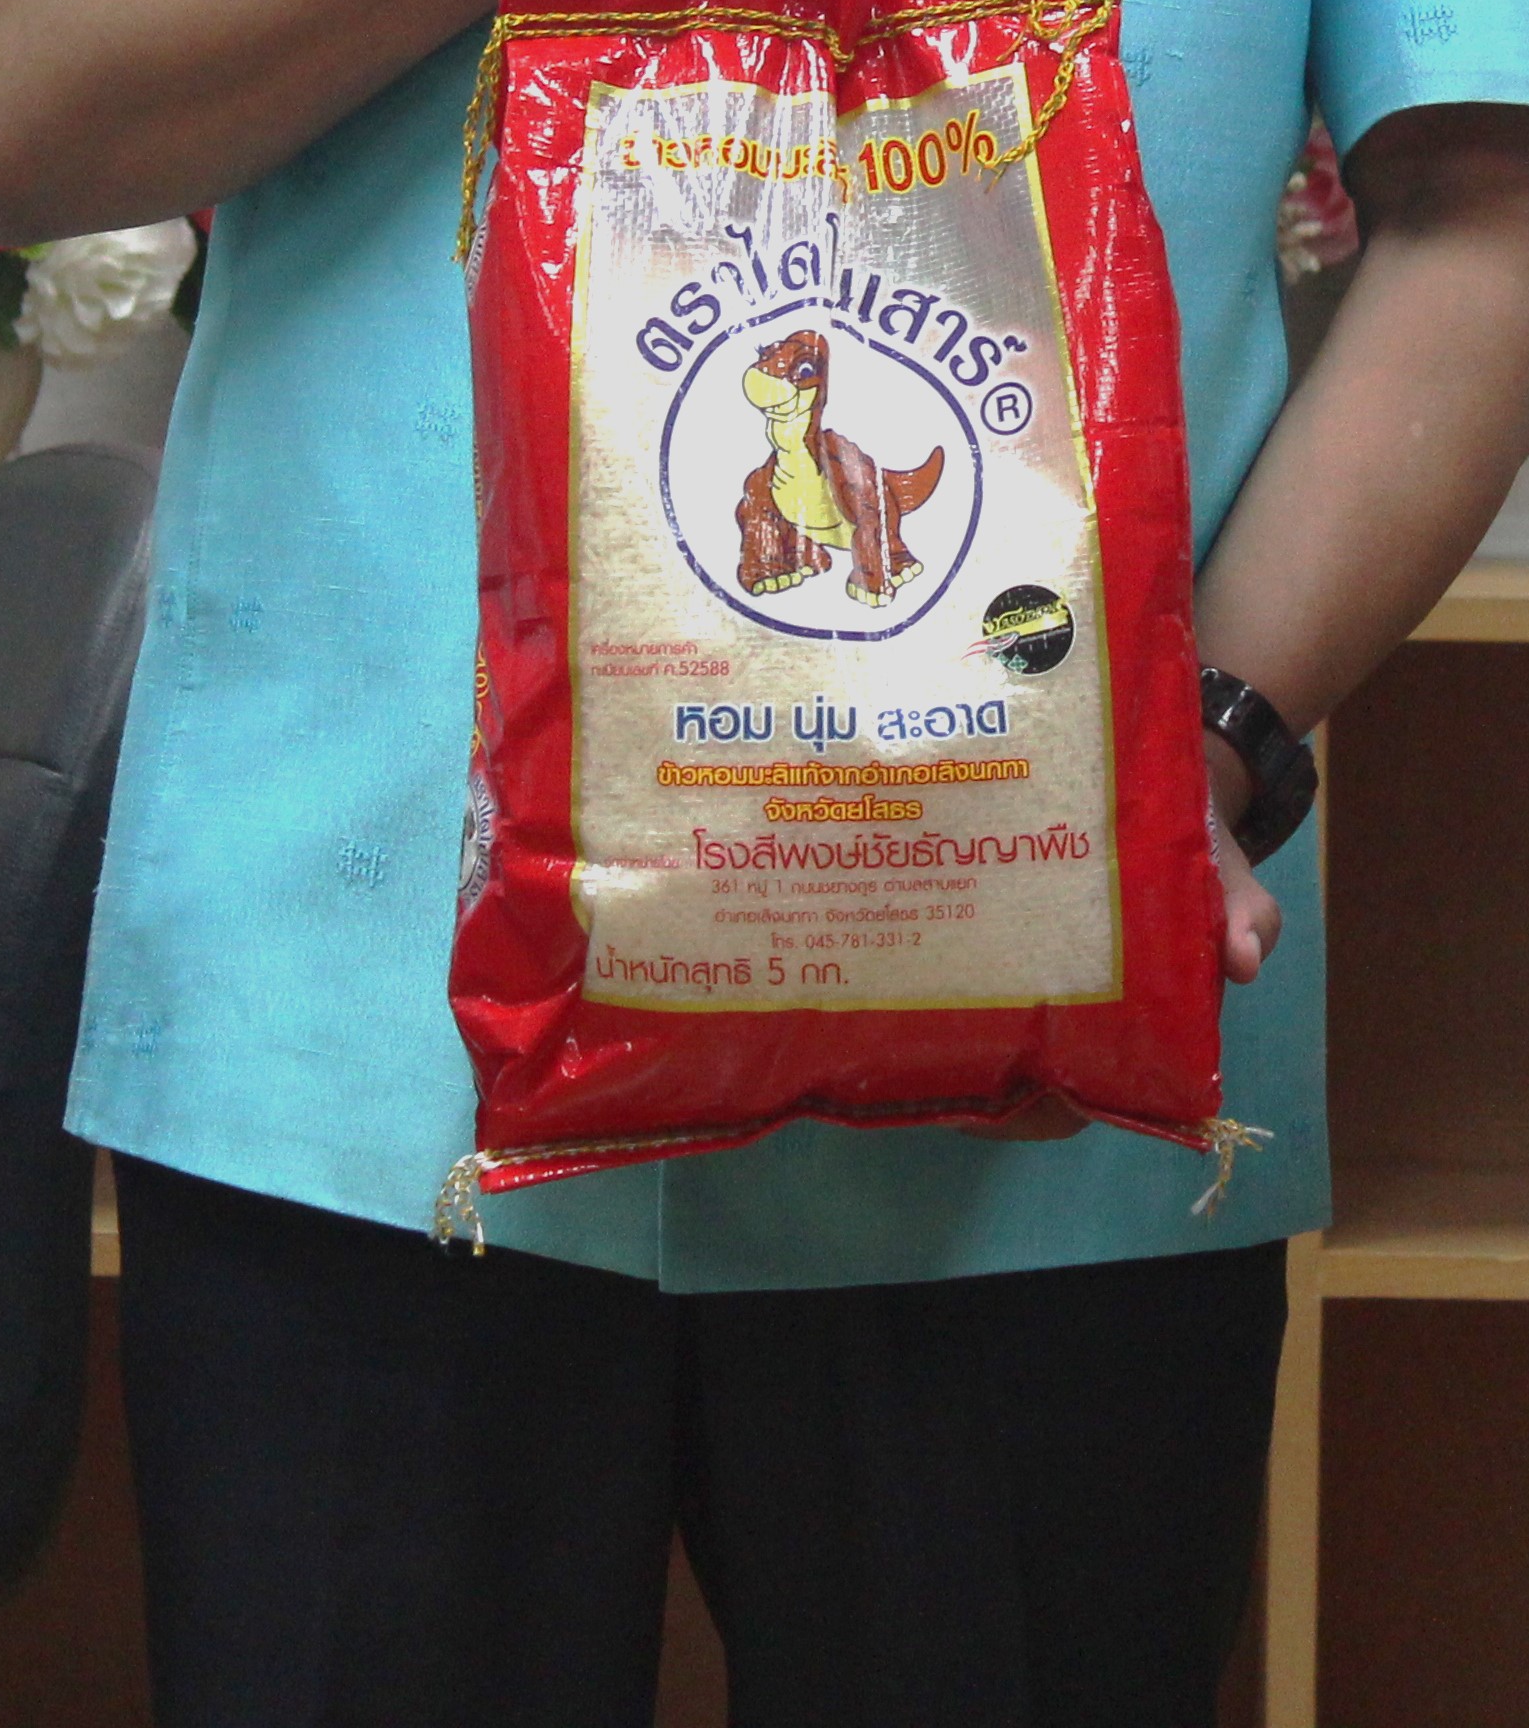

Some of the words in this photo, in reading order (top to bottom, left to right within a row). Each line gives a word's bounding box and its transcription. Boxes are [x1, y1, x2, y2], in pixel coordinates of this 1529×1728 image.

[858, 108, 998, 195] 100%
[675, 703, 774, 742] หอม
[792, 695, 858, 754] นุ่ม
[877, 698, 1009, 742] สะอาด
[657, 760, 1030, 788] ข้าวหอมมะลิแท้จากอำเภอเลิงนกทา
[764, 796, 923, 823] จังหวัดยโสธร
[692, 823, 1090, 870] โรงสีพงษ์ชัยธัญญาพืช
[712, 879, 738, 894] 361
[926, 903, 975, 922] 35120
[805, 931, 922, 950] 045-781-331-2
[596, 944, 752, 992] น้ำหนักสุทธิ
[768, 957, 786, 986] 5
[802, 962, 850, 985] กก.
